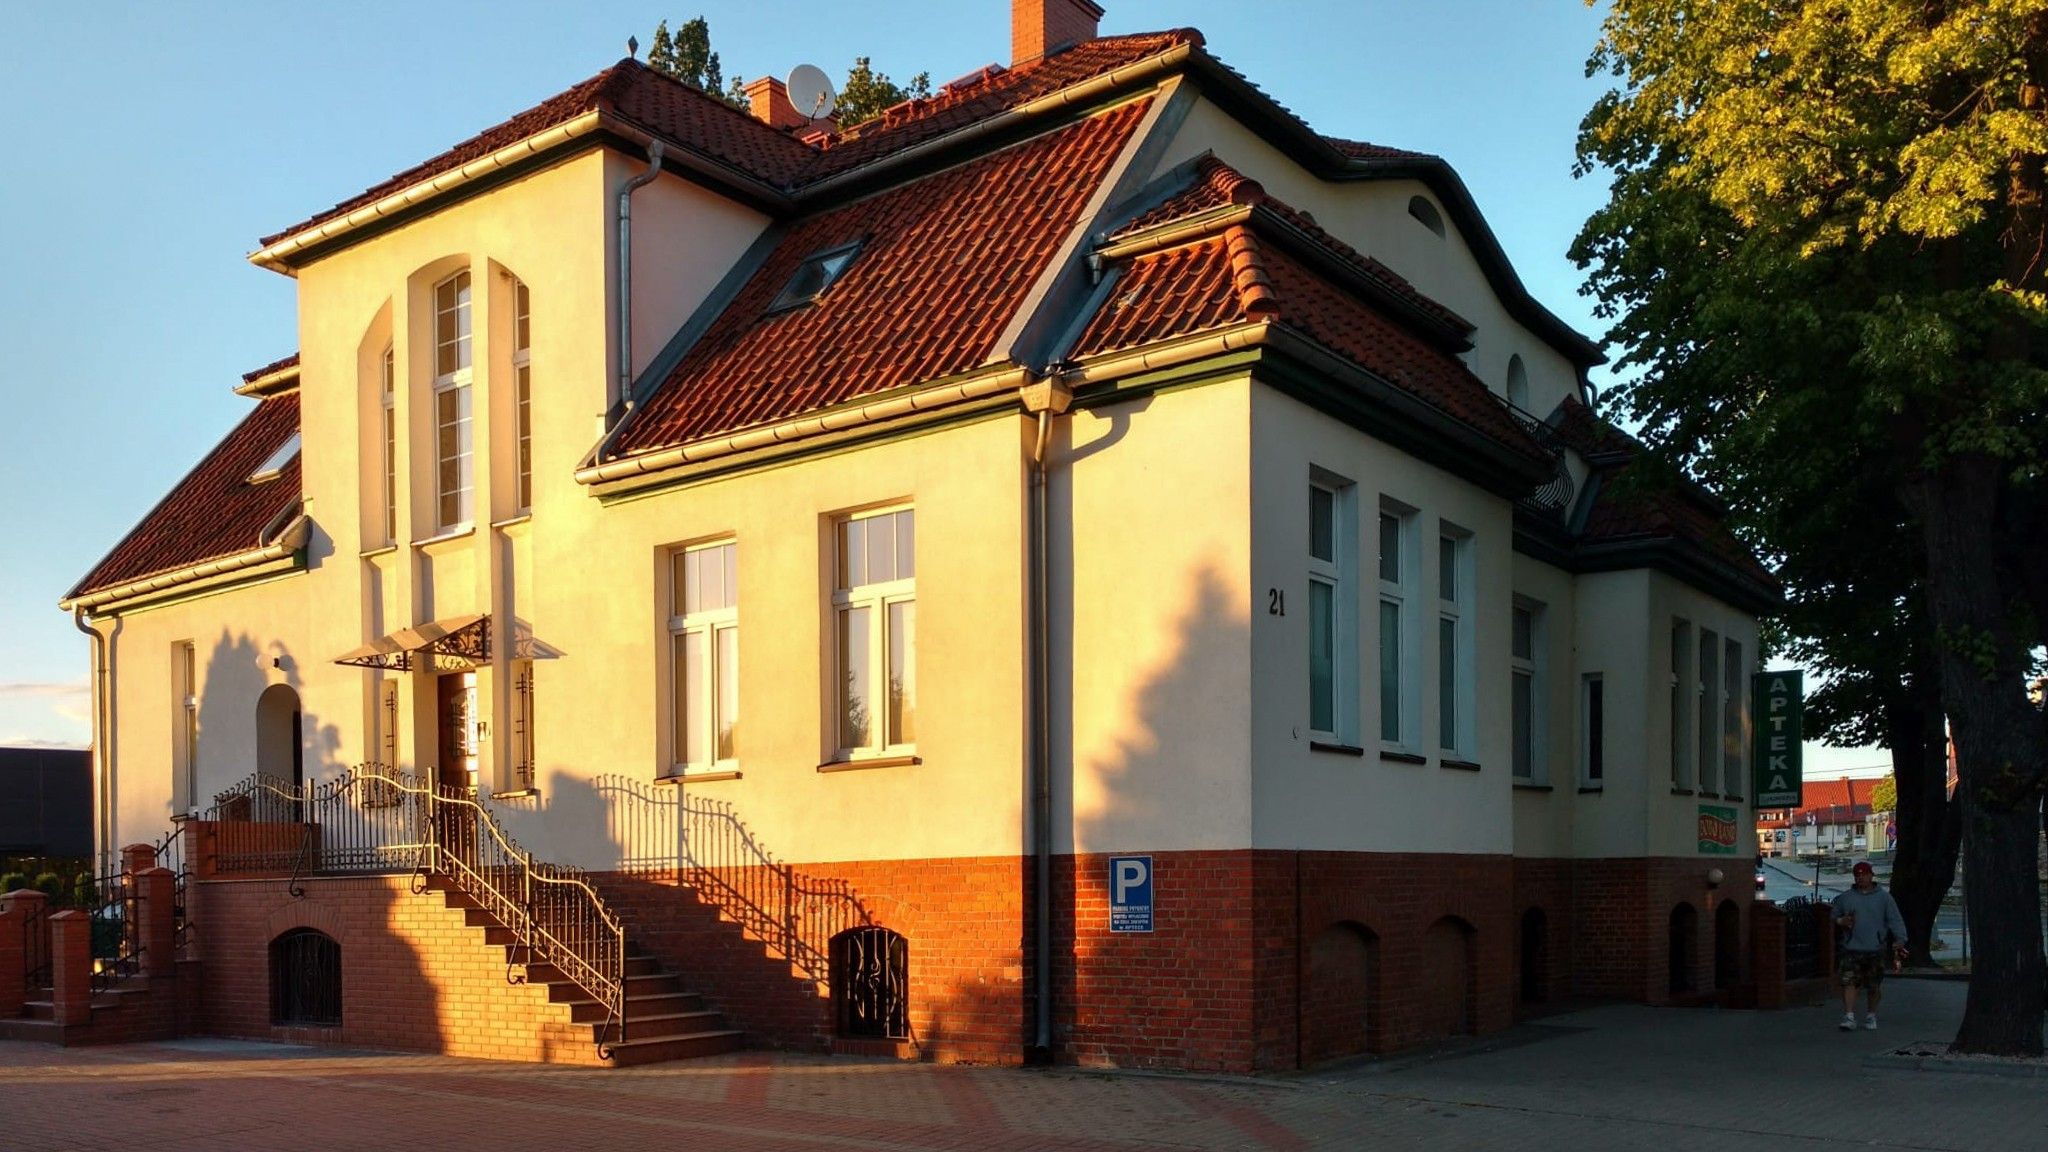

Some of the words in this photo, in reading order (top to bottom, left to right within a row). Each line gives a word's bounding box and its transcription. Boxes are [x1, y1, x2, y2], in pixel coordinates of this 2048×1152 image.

[1269, 588, 1285, 616] 21
[1769, 678, 1788, 790] APTEKA
[1117, 860, 1147, 903] P
